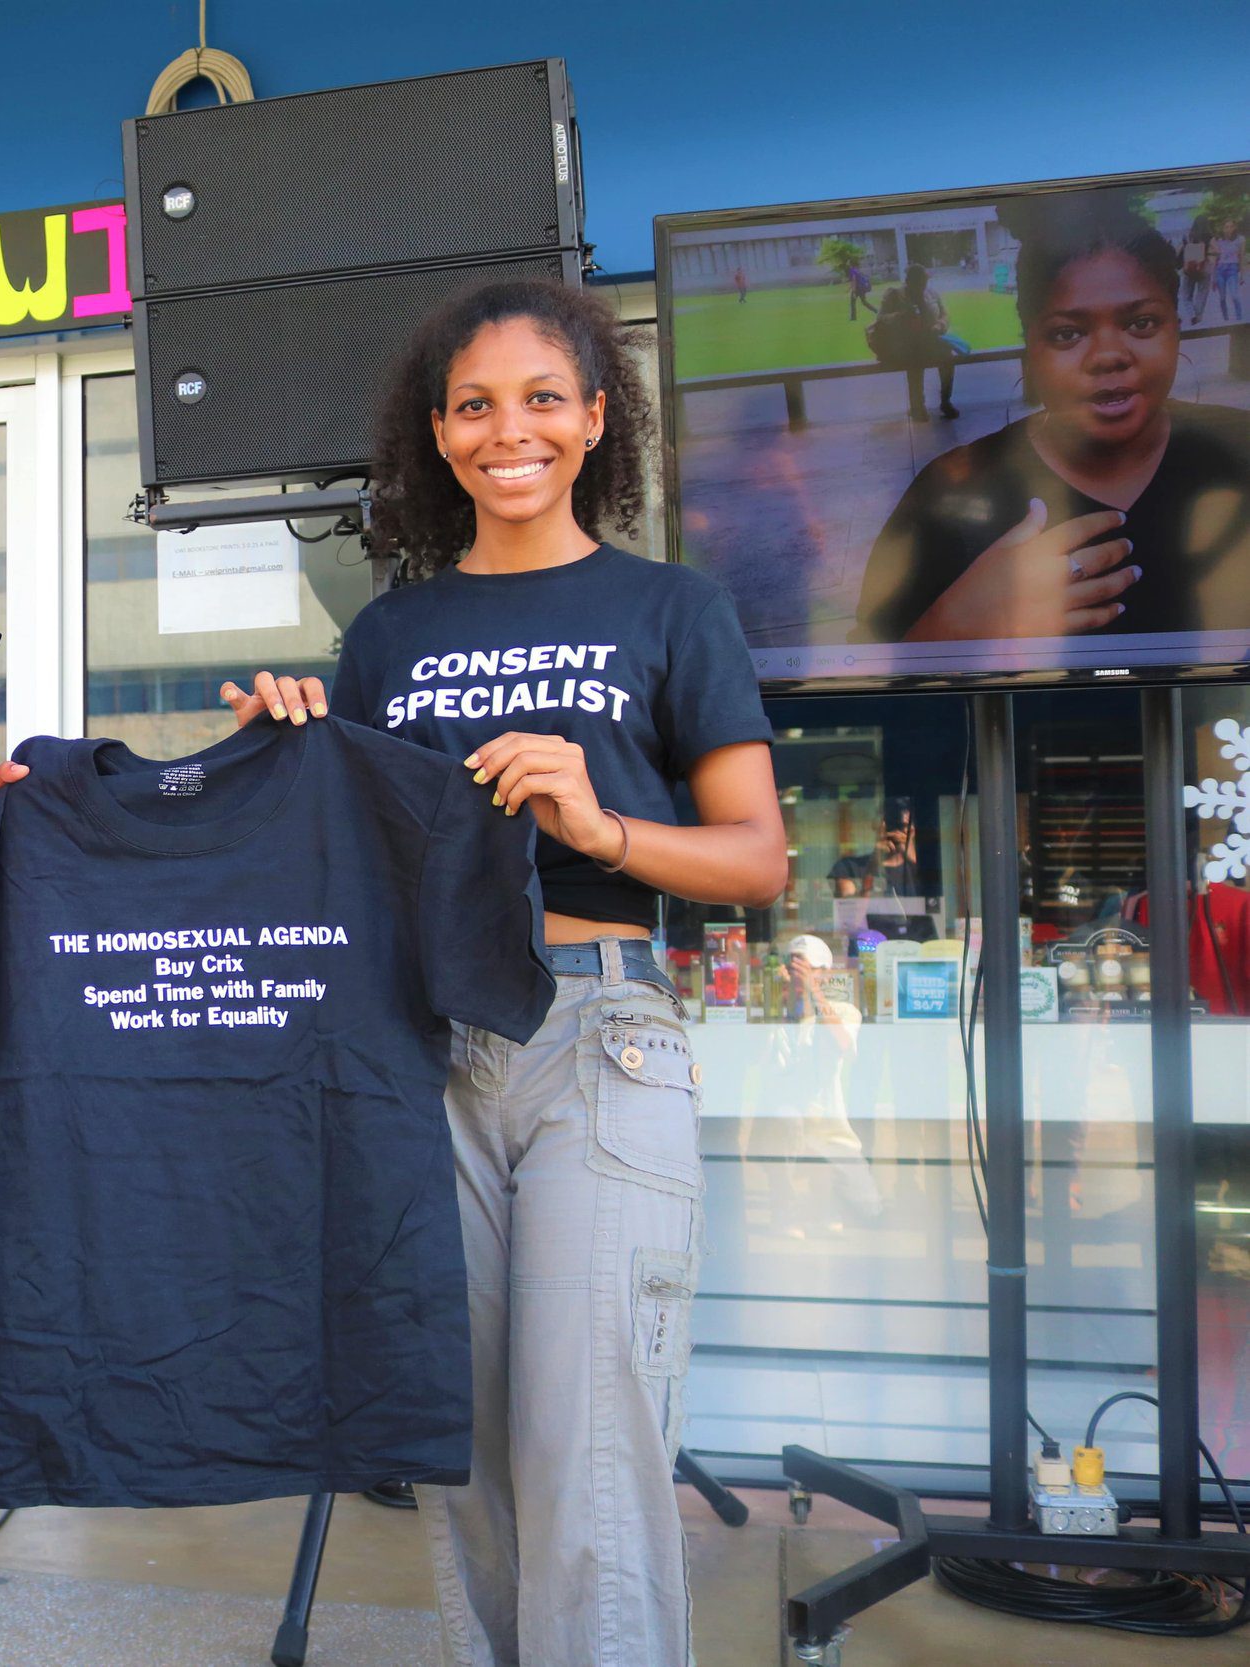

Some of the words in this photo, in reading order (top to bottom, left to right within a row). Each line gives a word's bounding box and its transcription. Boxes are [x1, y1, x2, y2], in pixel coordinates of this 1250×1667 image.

[555, 123, 566, 154] AUDIO
[557, 155, 568, 182] PLUS
[164, 194, 191, 212] RCF
[178, 381, 202, 396] RCF
[411, 644, 617, 682] CONSENT
[386, 678, 630, 729] SPECIALIST
[50, 935, 90, 954] THE
[96, 928, 251, 952] HOMOSEXUAL
[258, 926, 349, 946] AGENDA
[155, 958, 196, 978] Buy
[201, 954, 245, 974] Crix
[83, 984, 147, 1007] Spend
[153, 983, 204, 1002] Time
[210, 980, 254, 999] with
[261, 979, 326, 1001] Family
[110, 1010, 165, 1030] Work
[171, 1008, 201, 1027] for
[207, 1006, 288, 1028] Equality
